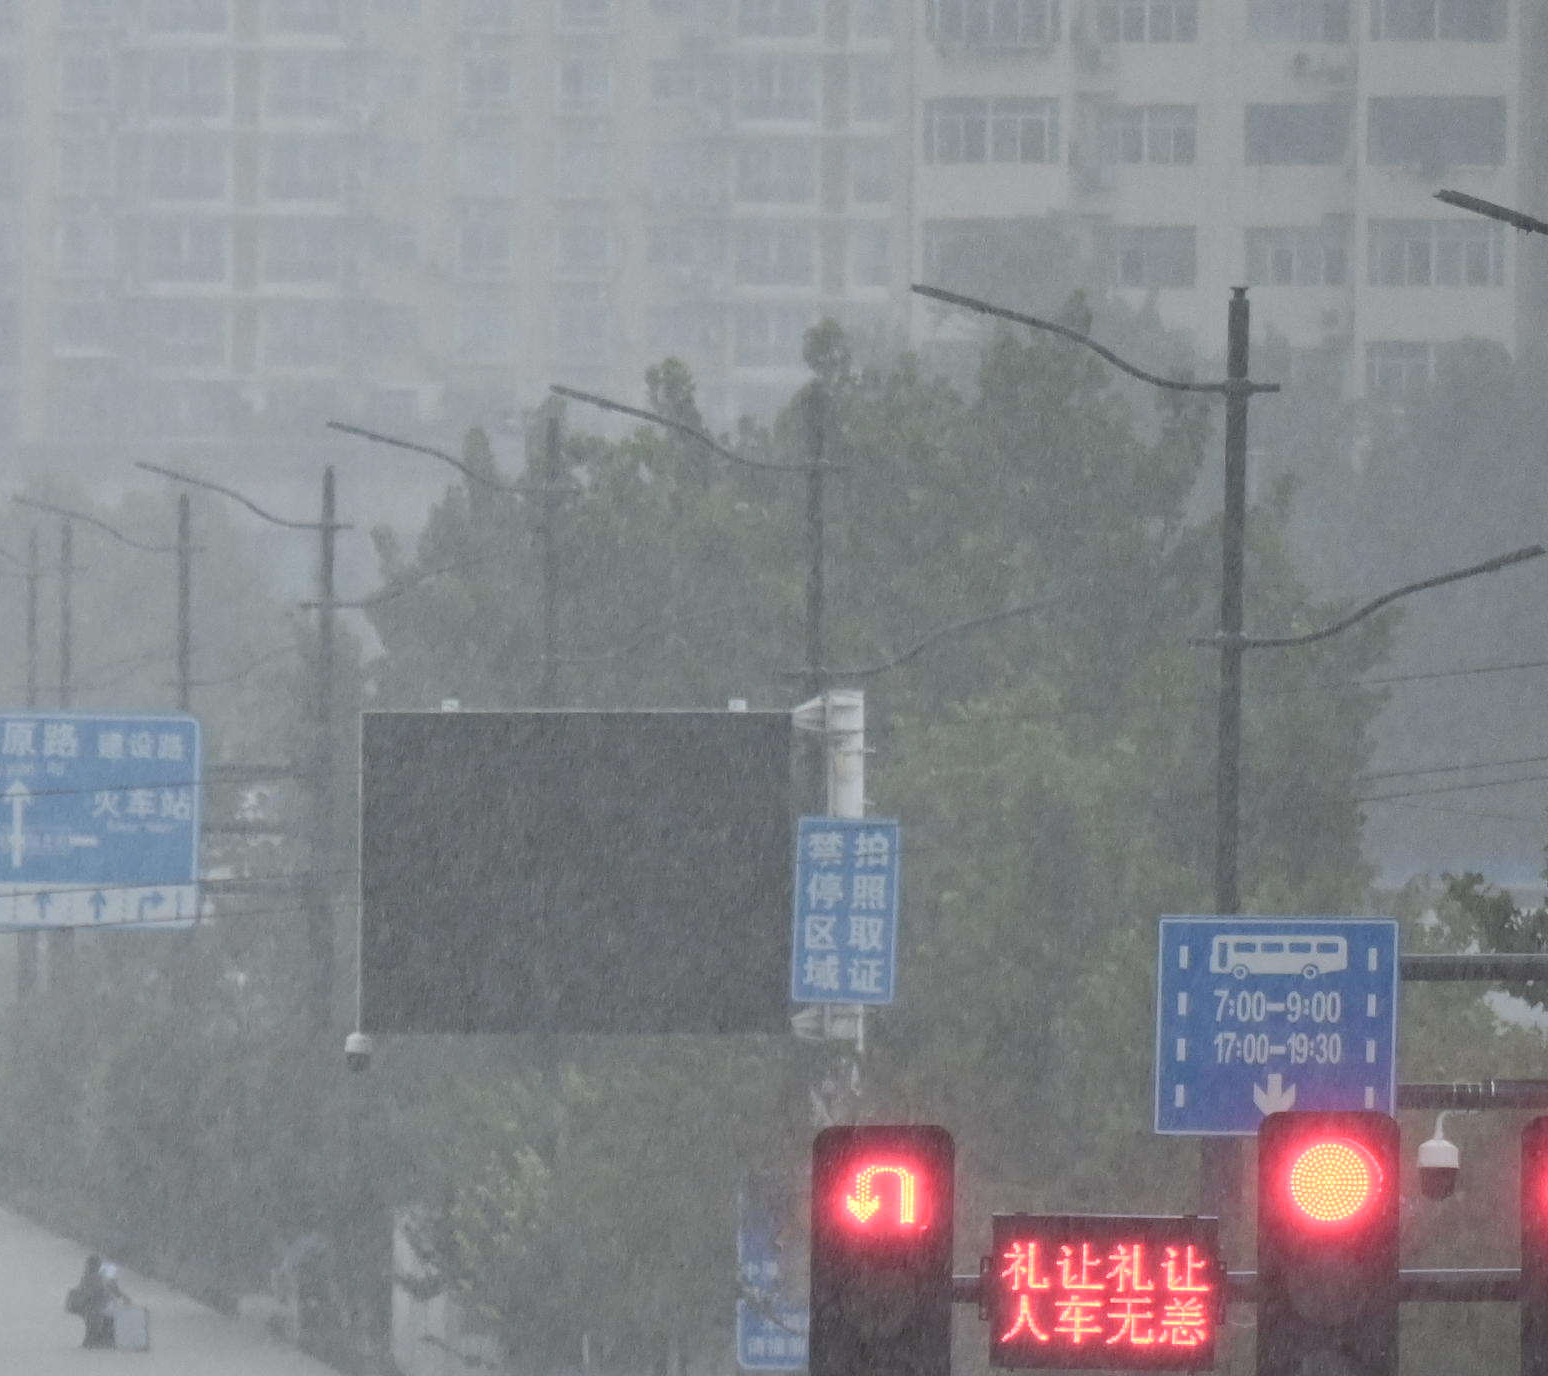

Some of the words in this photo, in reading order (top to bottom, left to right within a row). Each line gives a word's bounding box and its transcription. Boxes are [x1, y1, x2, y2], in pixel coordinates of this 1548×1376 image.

[93, 789, 191, 820] 火车站
[803, 831, 844, 991] 禁停区域
[848, 831, 889, 993] 拍照取证
[1001, 1242, 1210, 1292] 礼让礼让
[1001, 1295, 1207, 1346] 人车无恙
